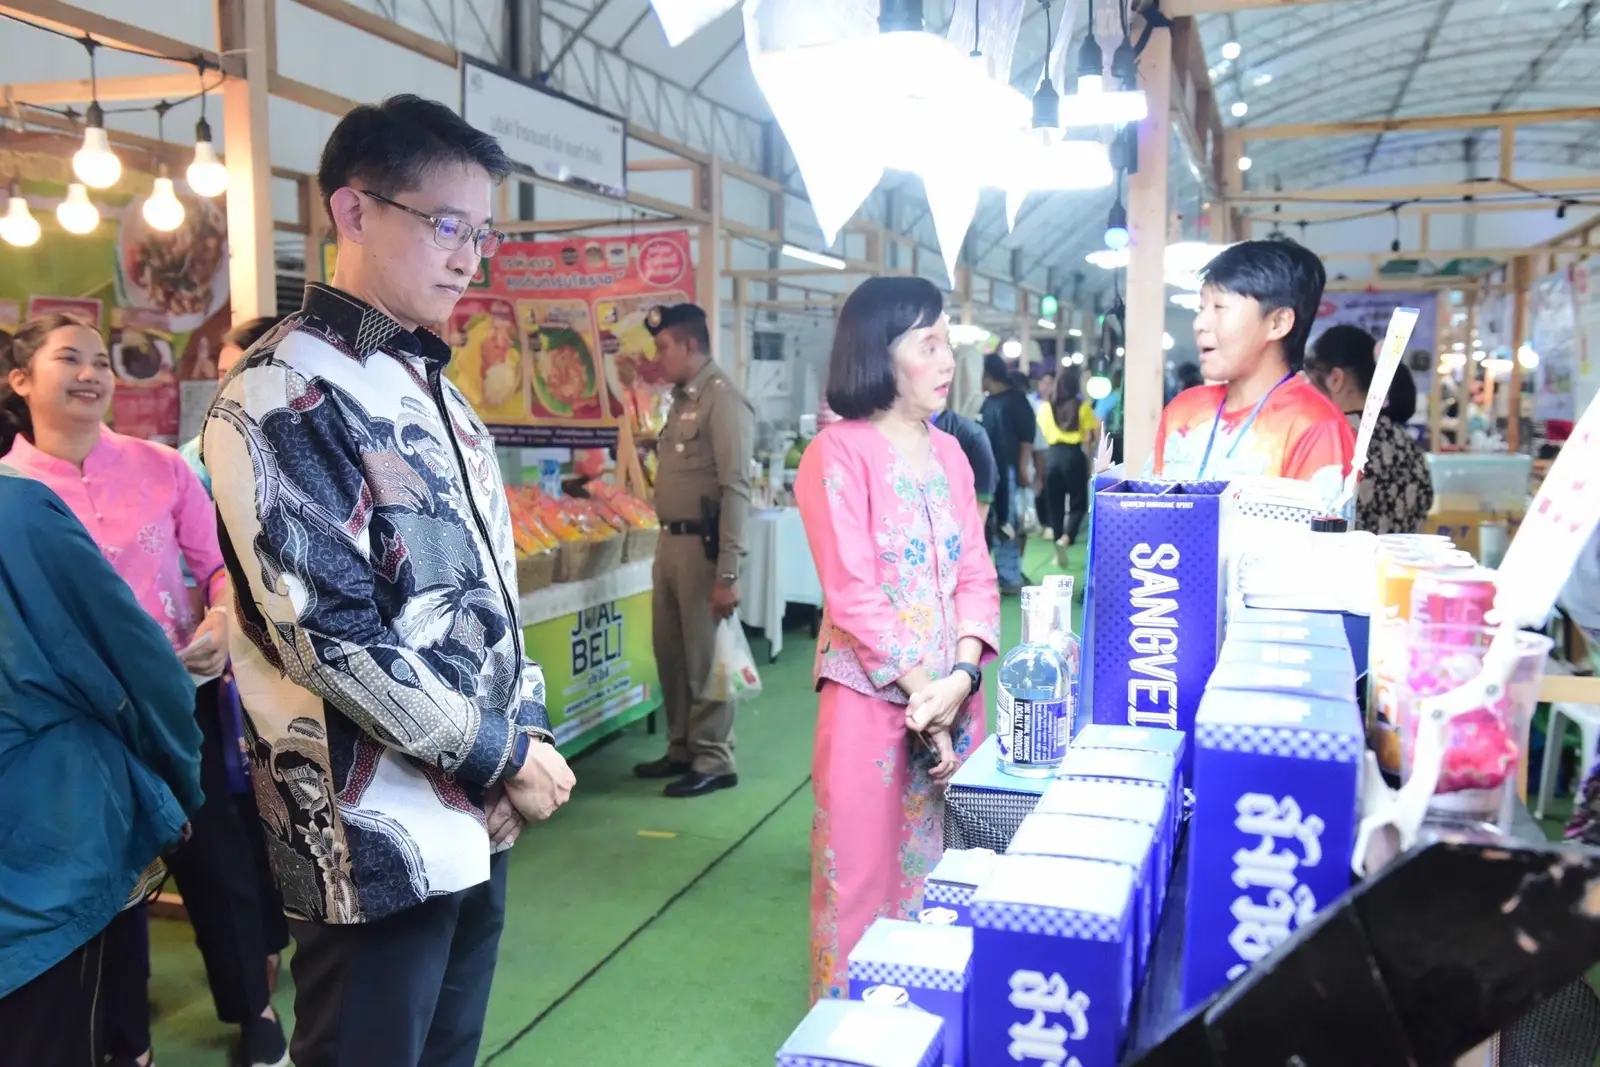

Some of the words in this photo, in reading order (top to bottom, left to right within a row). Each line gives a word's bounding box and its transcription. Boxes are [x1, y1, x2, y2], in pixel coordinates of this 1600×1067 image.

[572, 601, 622, 636] JUAL
[572, 622, 621, 676] BELI
[1014, 702, 1024, 729] LOCALLY
[1014, 729, 1024, 760] PRODUCED
